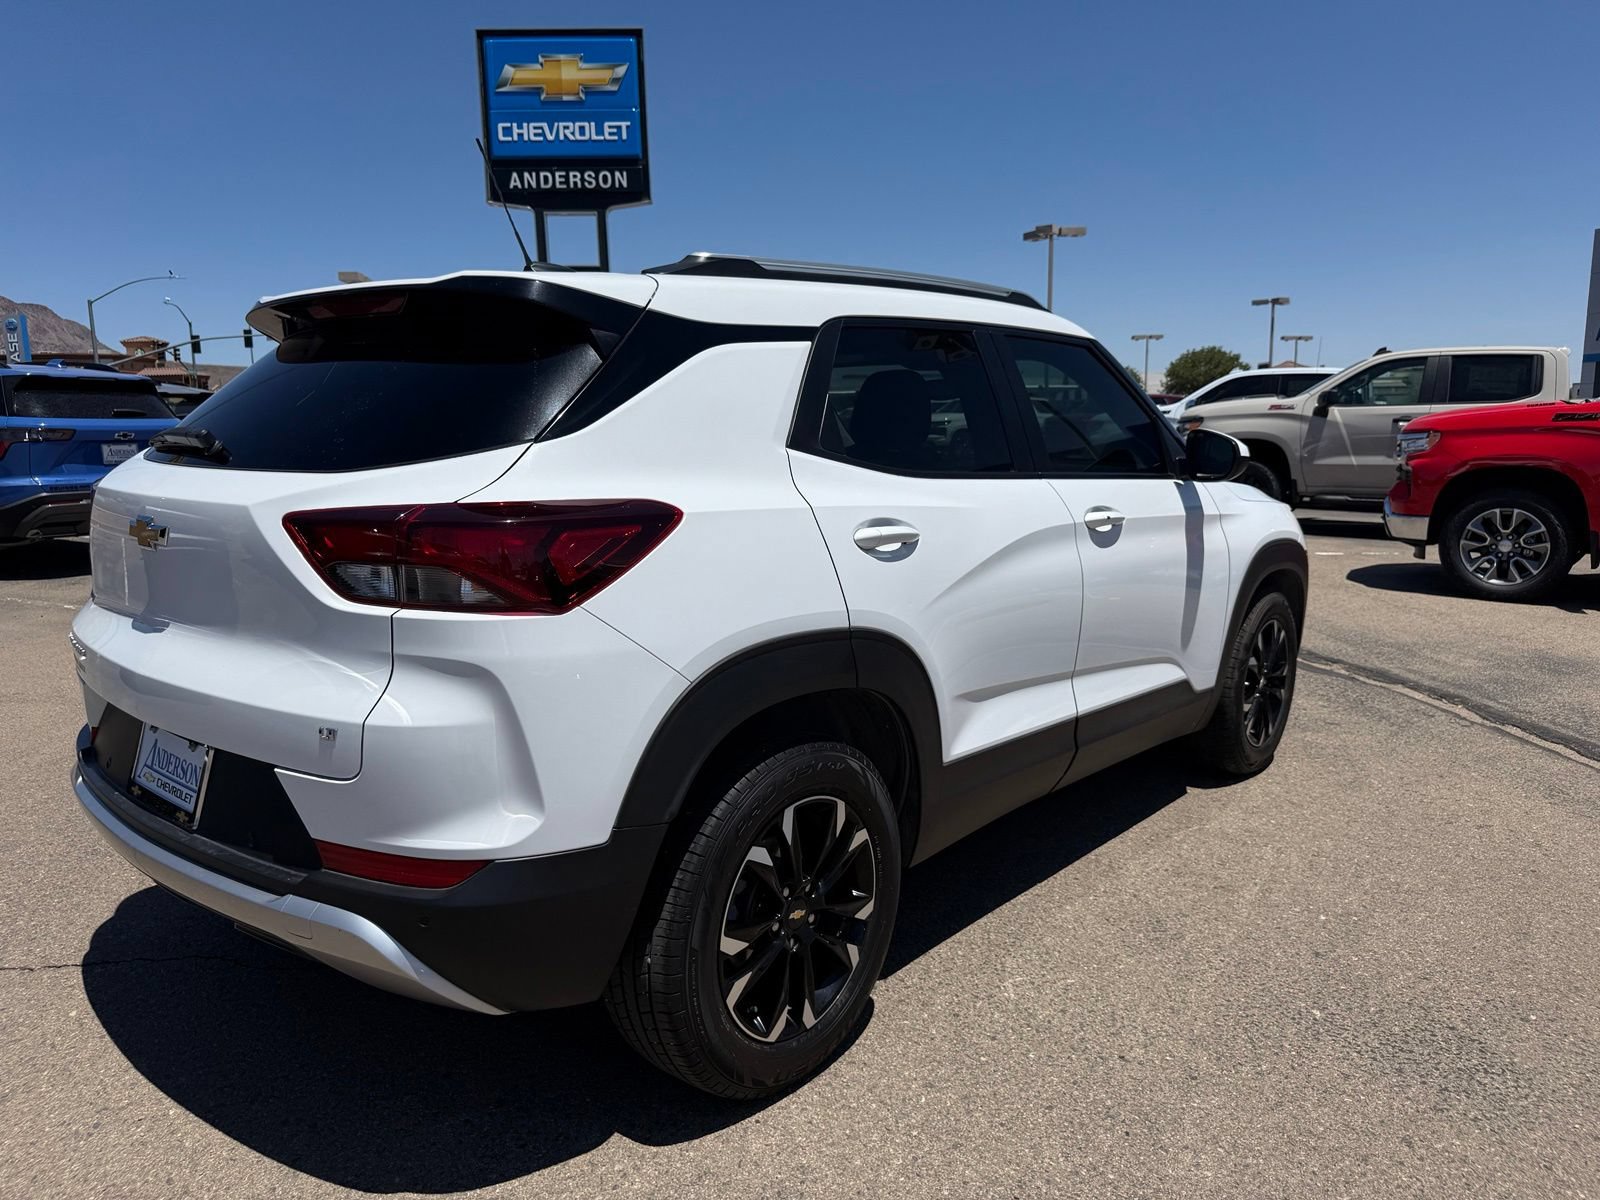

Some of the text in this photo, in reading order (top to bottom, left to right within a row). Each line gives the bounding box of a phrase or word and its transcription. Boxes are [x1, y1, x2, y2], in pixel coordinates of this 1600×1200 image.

[497, 121, 631, 142] CHEVROLET
[509, 171, 628, 189] ANDERSON
[137, 738, 202, 787] ANDERSON
[156, 778, 194, 805] CHEVROLET
